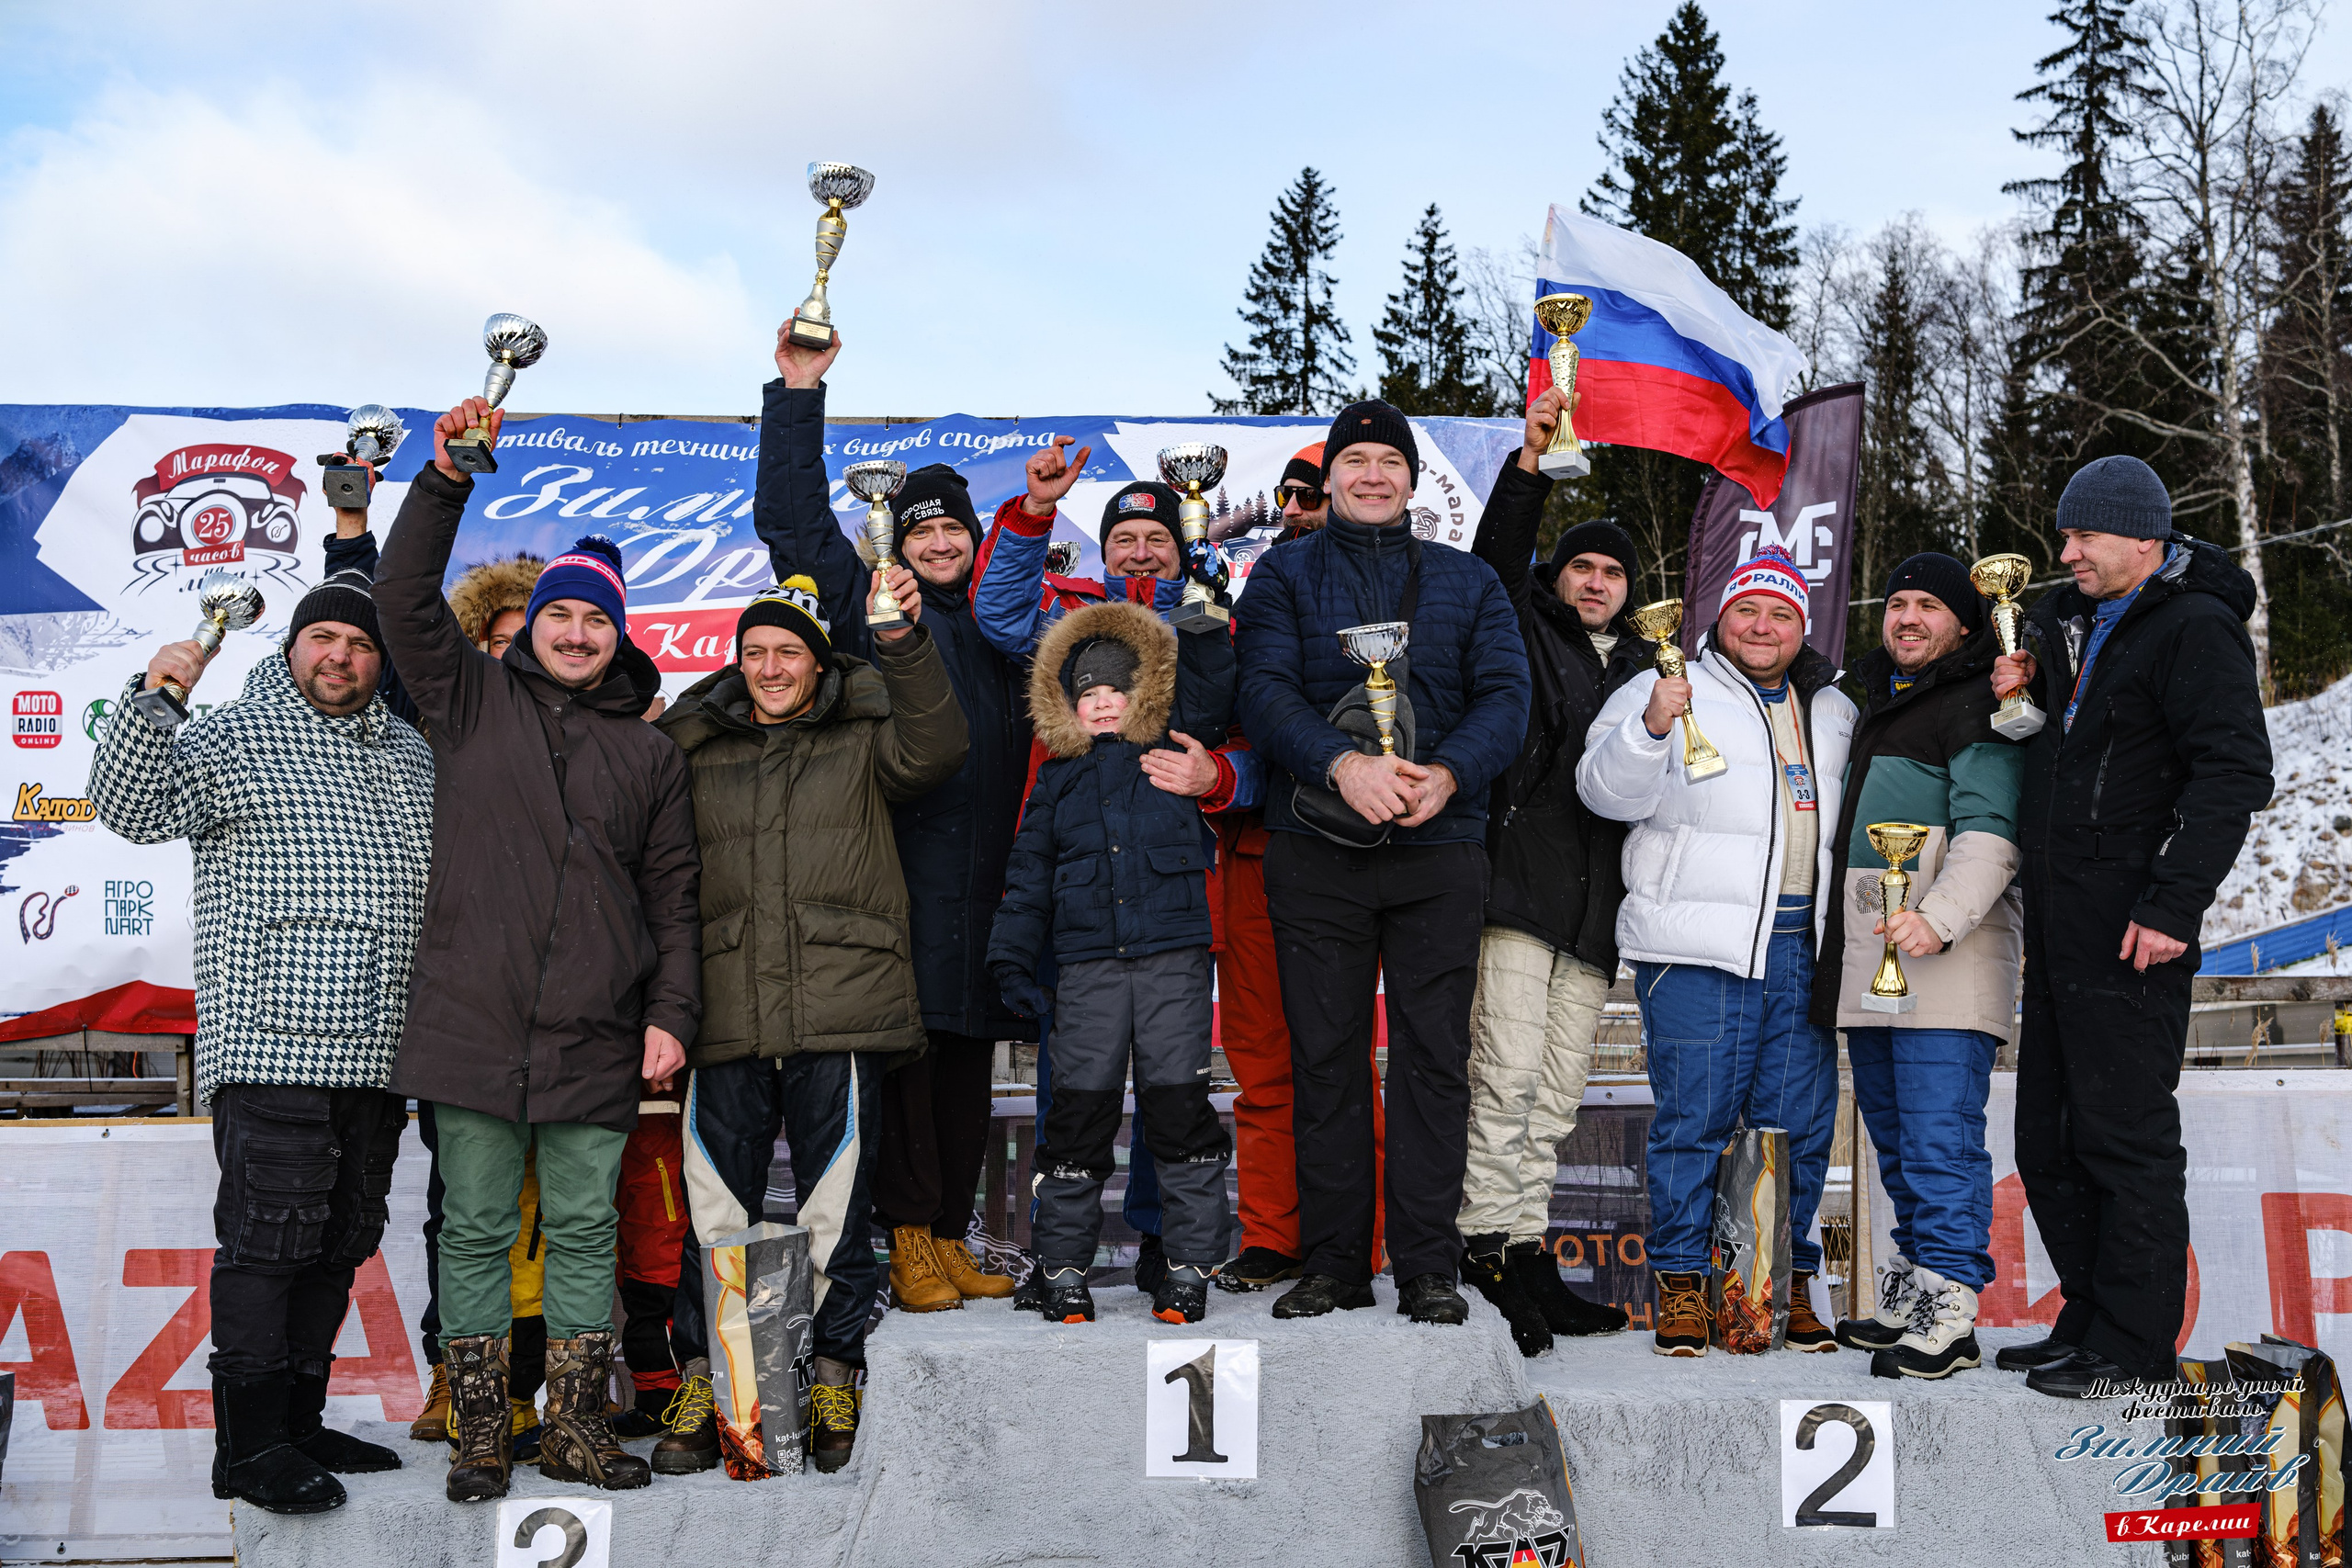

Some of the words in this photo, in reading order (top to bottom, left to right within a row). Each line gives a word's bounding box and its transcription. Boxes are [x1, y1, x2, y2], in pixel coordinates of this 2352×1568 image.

[842, 428, 933, 457] видов
[938, 430, 1057, 456] спорта
[168, 447, 280, 479] Марафон
[900, 498, 942, 523] ХОРОШАЯ
[914, 506, 944, 520] СВЯЗЬ
[198, 512, 231, 538] 25
[189, 541, 242, 563] часов
[1728, 581, 1738, 594] Я
[1753, 572, 1805, 604] РАЛЛИ
[17, 694, 57, 713] MOTO
[18, 717, 56, 733] RADIO
[1796, 789, 1811, 800] 3-3
[36, 824, 96, 833] МАГАЗИНОВ
[105, 880, 153, 899] АГРО
[105, 899, 153, 917] ПАРК
[1164, 1343, 1228, 1463] 1
[1794, 1403, 1877, 1528] 2
